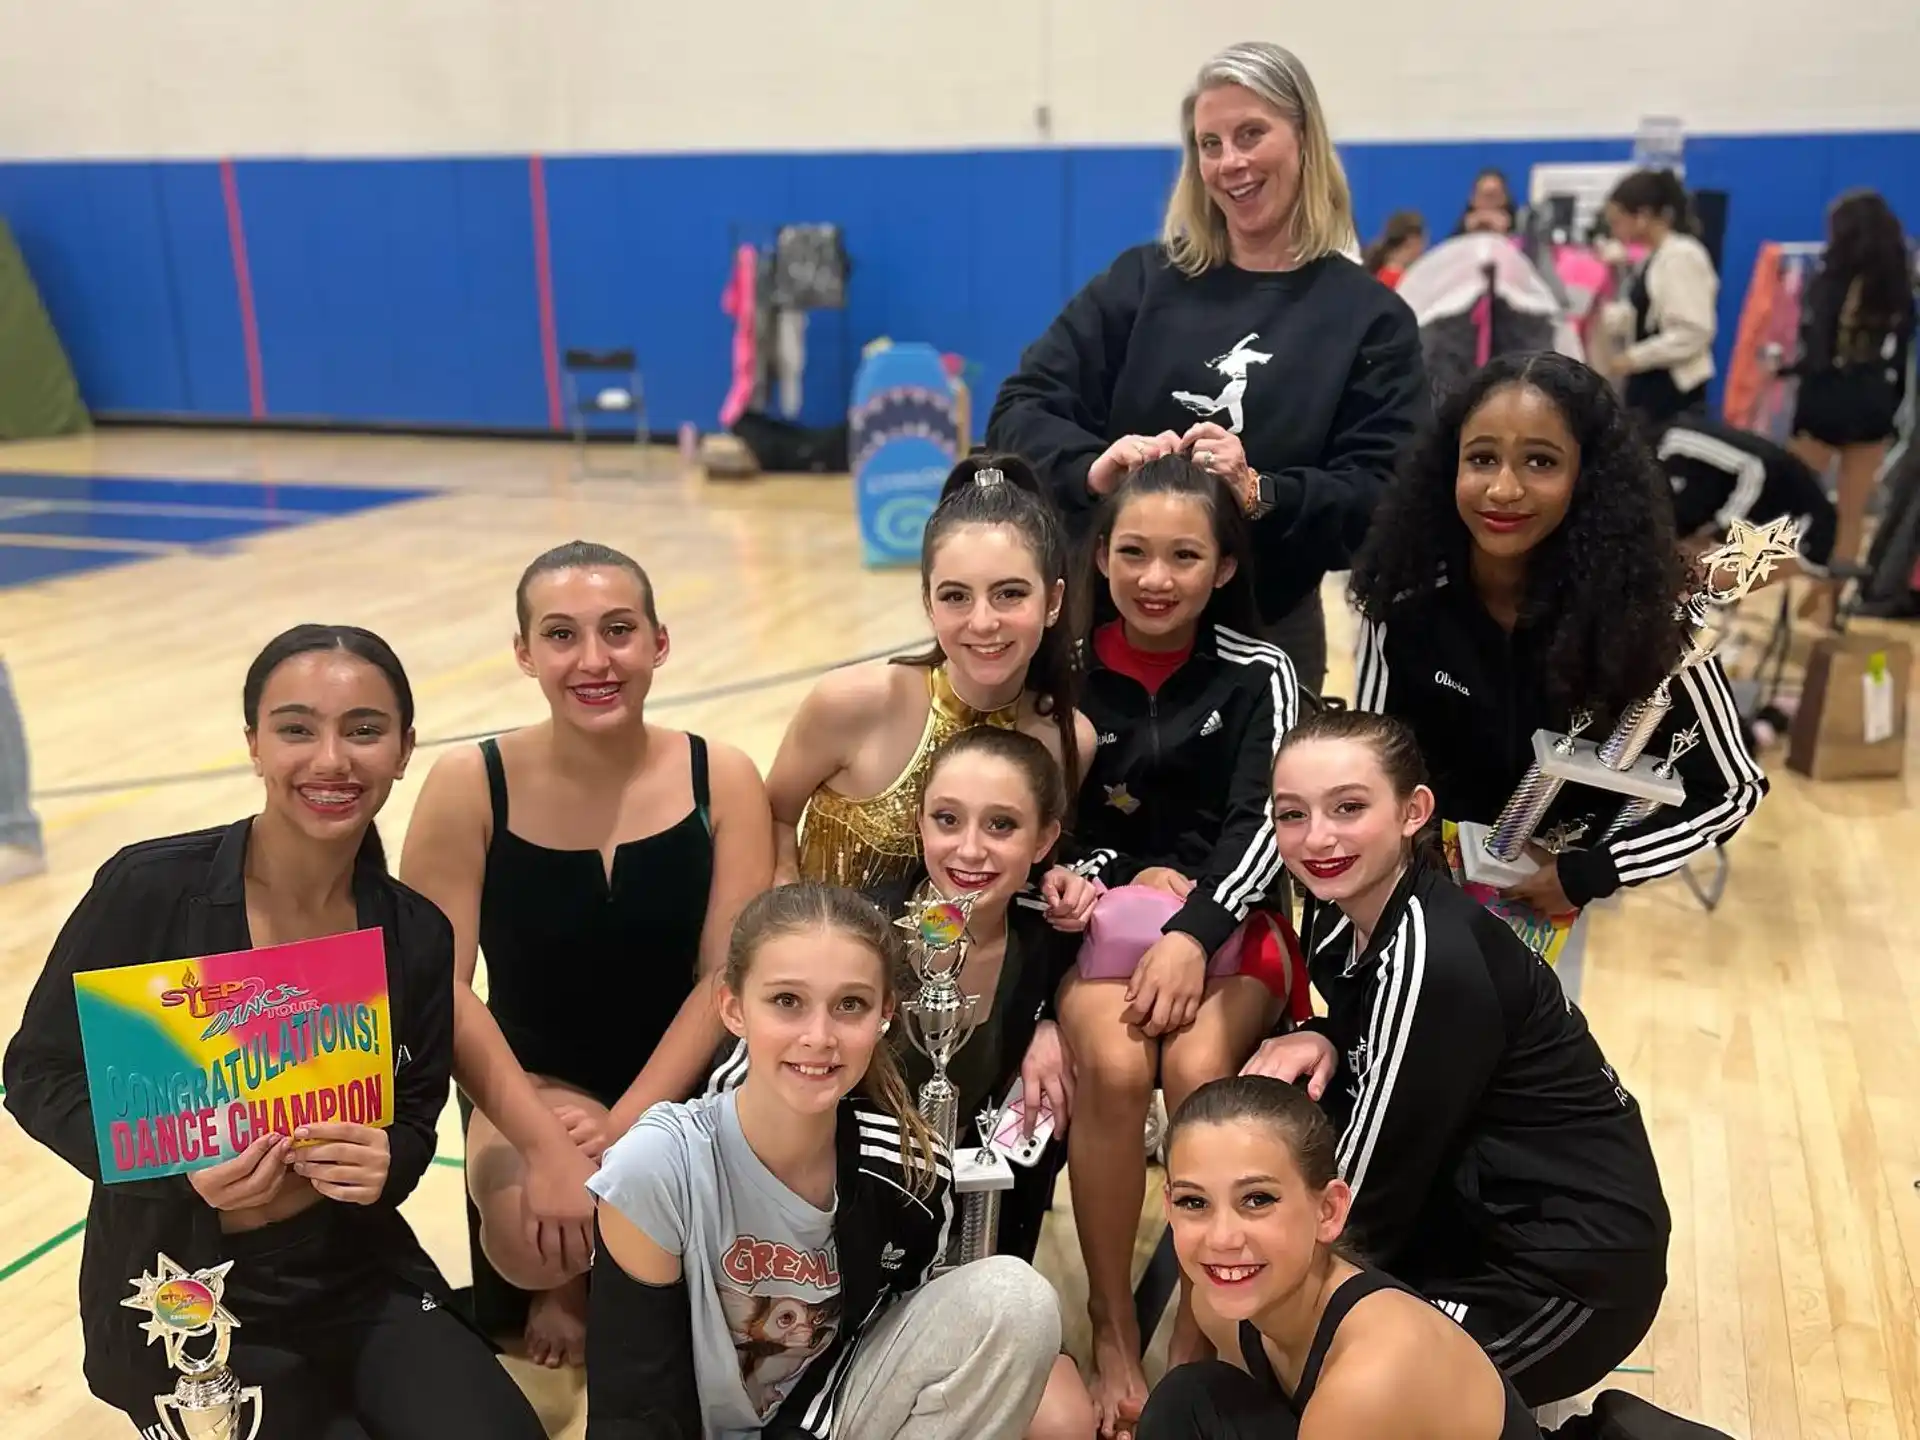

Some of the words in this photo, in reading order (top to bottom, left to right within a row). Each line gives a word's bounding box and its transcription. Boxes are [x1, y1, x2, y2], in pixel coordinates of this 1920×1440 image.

[1434, 670, 1470, 696] Olivia
[161, 982, 243, 1008] STEP
[263, 999, 320, 1019] TOUR
[106, 1003, 379, 1119] CONGRATULATIONS!
[110, 1107, 220, 1171] DANCE
[228, 1073, 382, 1153] CHAMPION
[722, 1235, 840, 1289] GREML
